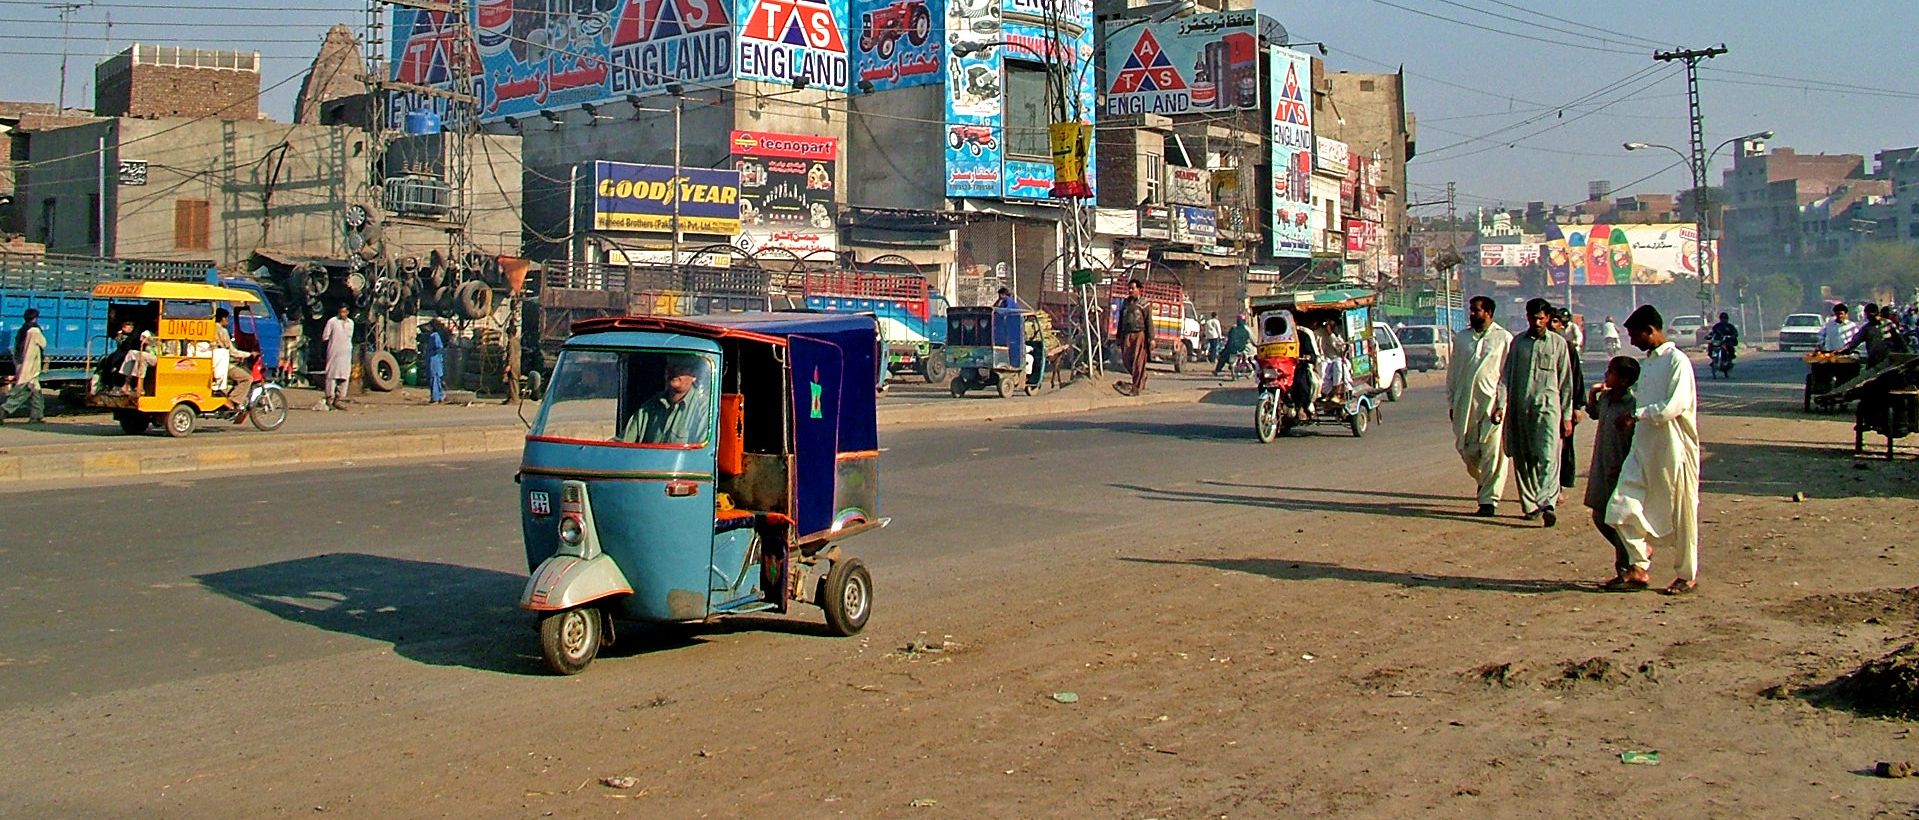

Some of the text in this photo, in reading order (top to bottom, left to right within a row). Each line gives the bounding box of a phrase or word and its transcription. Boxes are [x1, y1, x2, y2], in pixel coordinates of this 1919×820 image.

[612, 31, 732, 92] ENGLAND
[741, 43, 846, 88] ENGLAND
[1108, 93, 1189, 115] ENGLAND
[760, 137, 833, 155] tecnopart
[1273, 124, 1310, 149] ENGLAND
[599, 177, 738, 205] GOODYEAR
[626, 219, 653, 229] Brothers
[94, 285, 140, 295] QINGQI
[167, 320, 208, 335] QINGQI
